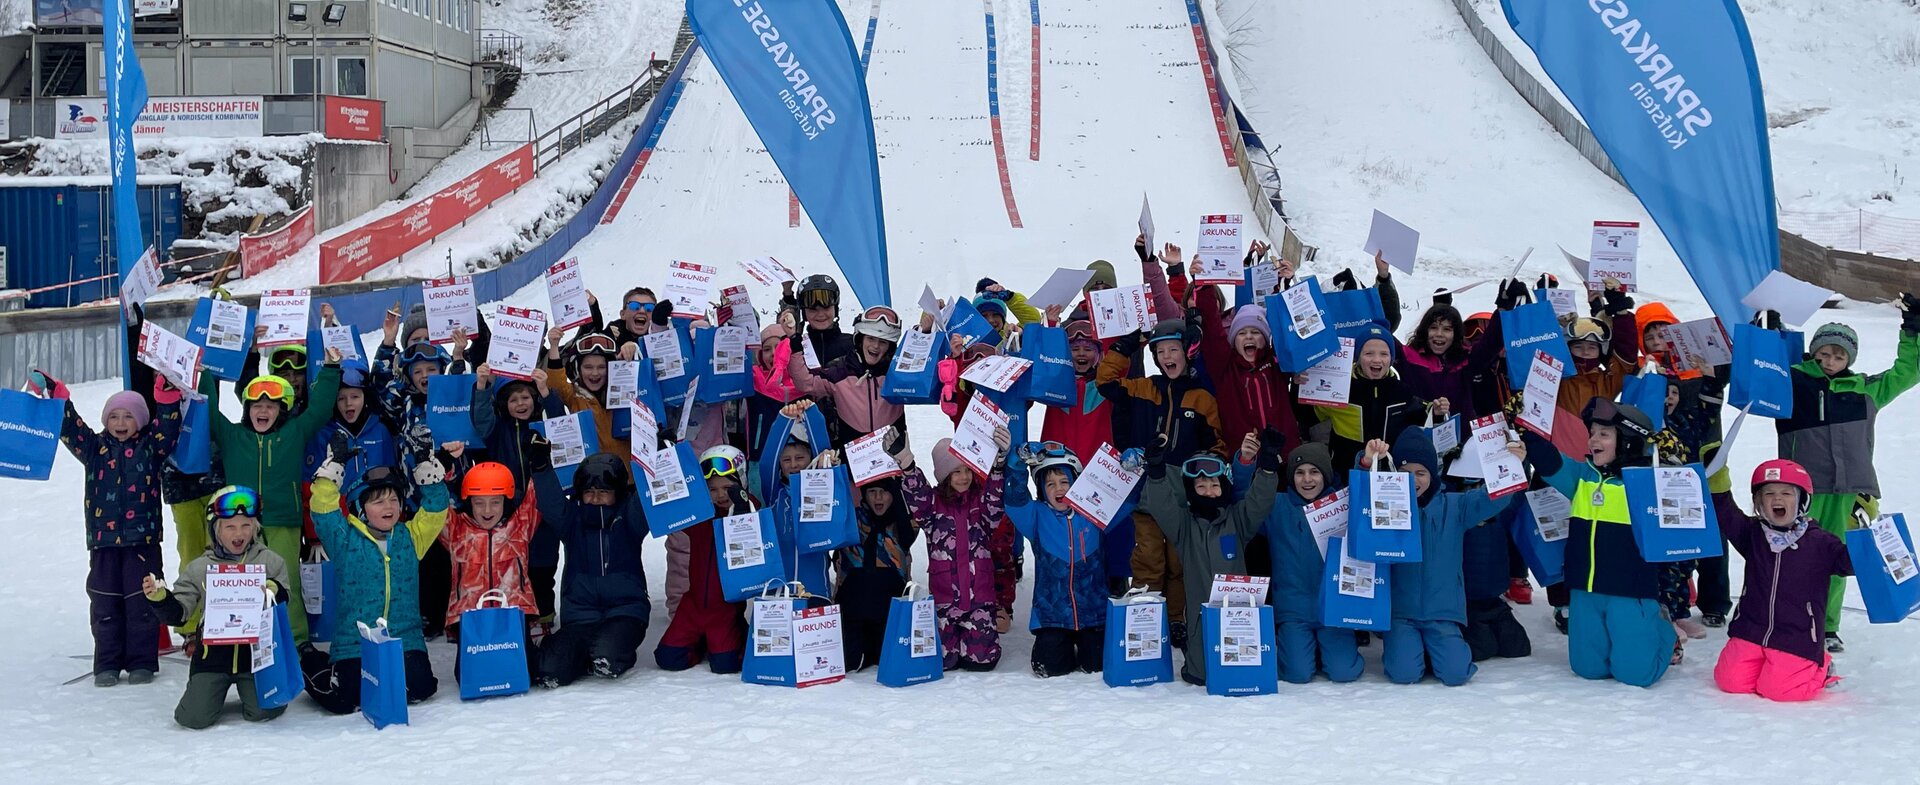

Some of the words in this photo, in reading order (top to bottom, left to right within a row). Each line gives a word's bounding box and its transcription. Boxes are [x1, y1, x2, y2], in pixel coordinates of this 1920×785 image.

[152, 101, 259, 113] MEISTERSCHAFTEN
[134, 124, 165, 134] Jänner
[1202, 228, 1237, 237] URKUNDE
[549, 270, 577, 288] URKUNDE
[672, 271, 710, 283] URKUNDE
[1593, 270, 1632, 279] URKUNDE
[429, 288, 469, 300] URKUNDE
[265, 299, 304, 307] URKUNDE
[1132, 289, 1146, 329] URKUNDE
[499, 319, 539, 333] URKUNDE
[1511, 332, 1558, 347] #glaubandich
[995, 360, 1021, 387] URKUNDE
[1532, 364, 1557, 384] URKUNDE
[432, 405, 470, 414] #glauband
[972, 404, 999, 429] URKUND
[633, 408, 656, 429] URKUNDE
[1621, 419, 1649, 436] SCO
[851, 437, 884, 454] URKUND
[1097, 456, 1133, 485] URKUNDE
[1313, 503, 1350, 523] URKUND
[668, 517, 692, 530] SPARKASSE
[212, 579, 260, 588] URKUNDE
[1218, 585, 1262, 594] URKUNDE
[798, 619, 837, 633] URKUNDE
[1343, 617, 1368, 625] SPARKASSE
[467, 641, 519, 655] #glaubandich
